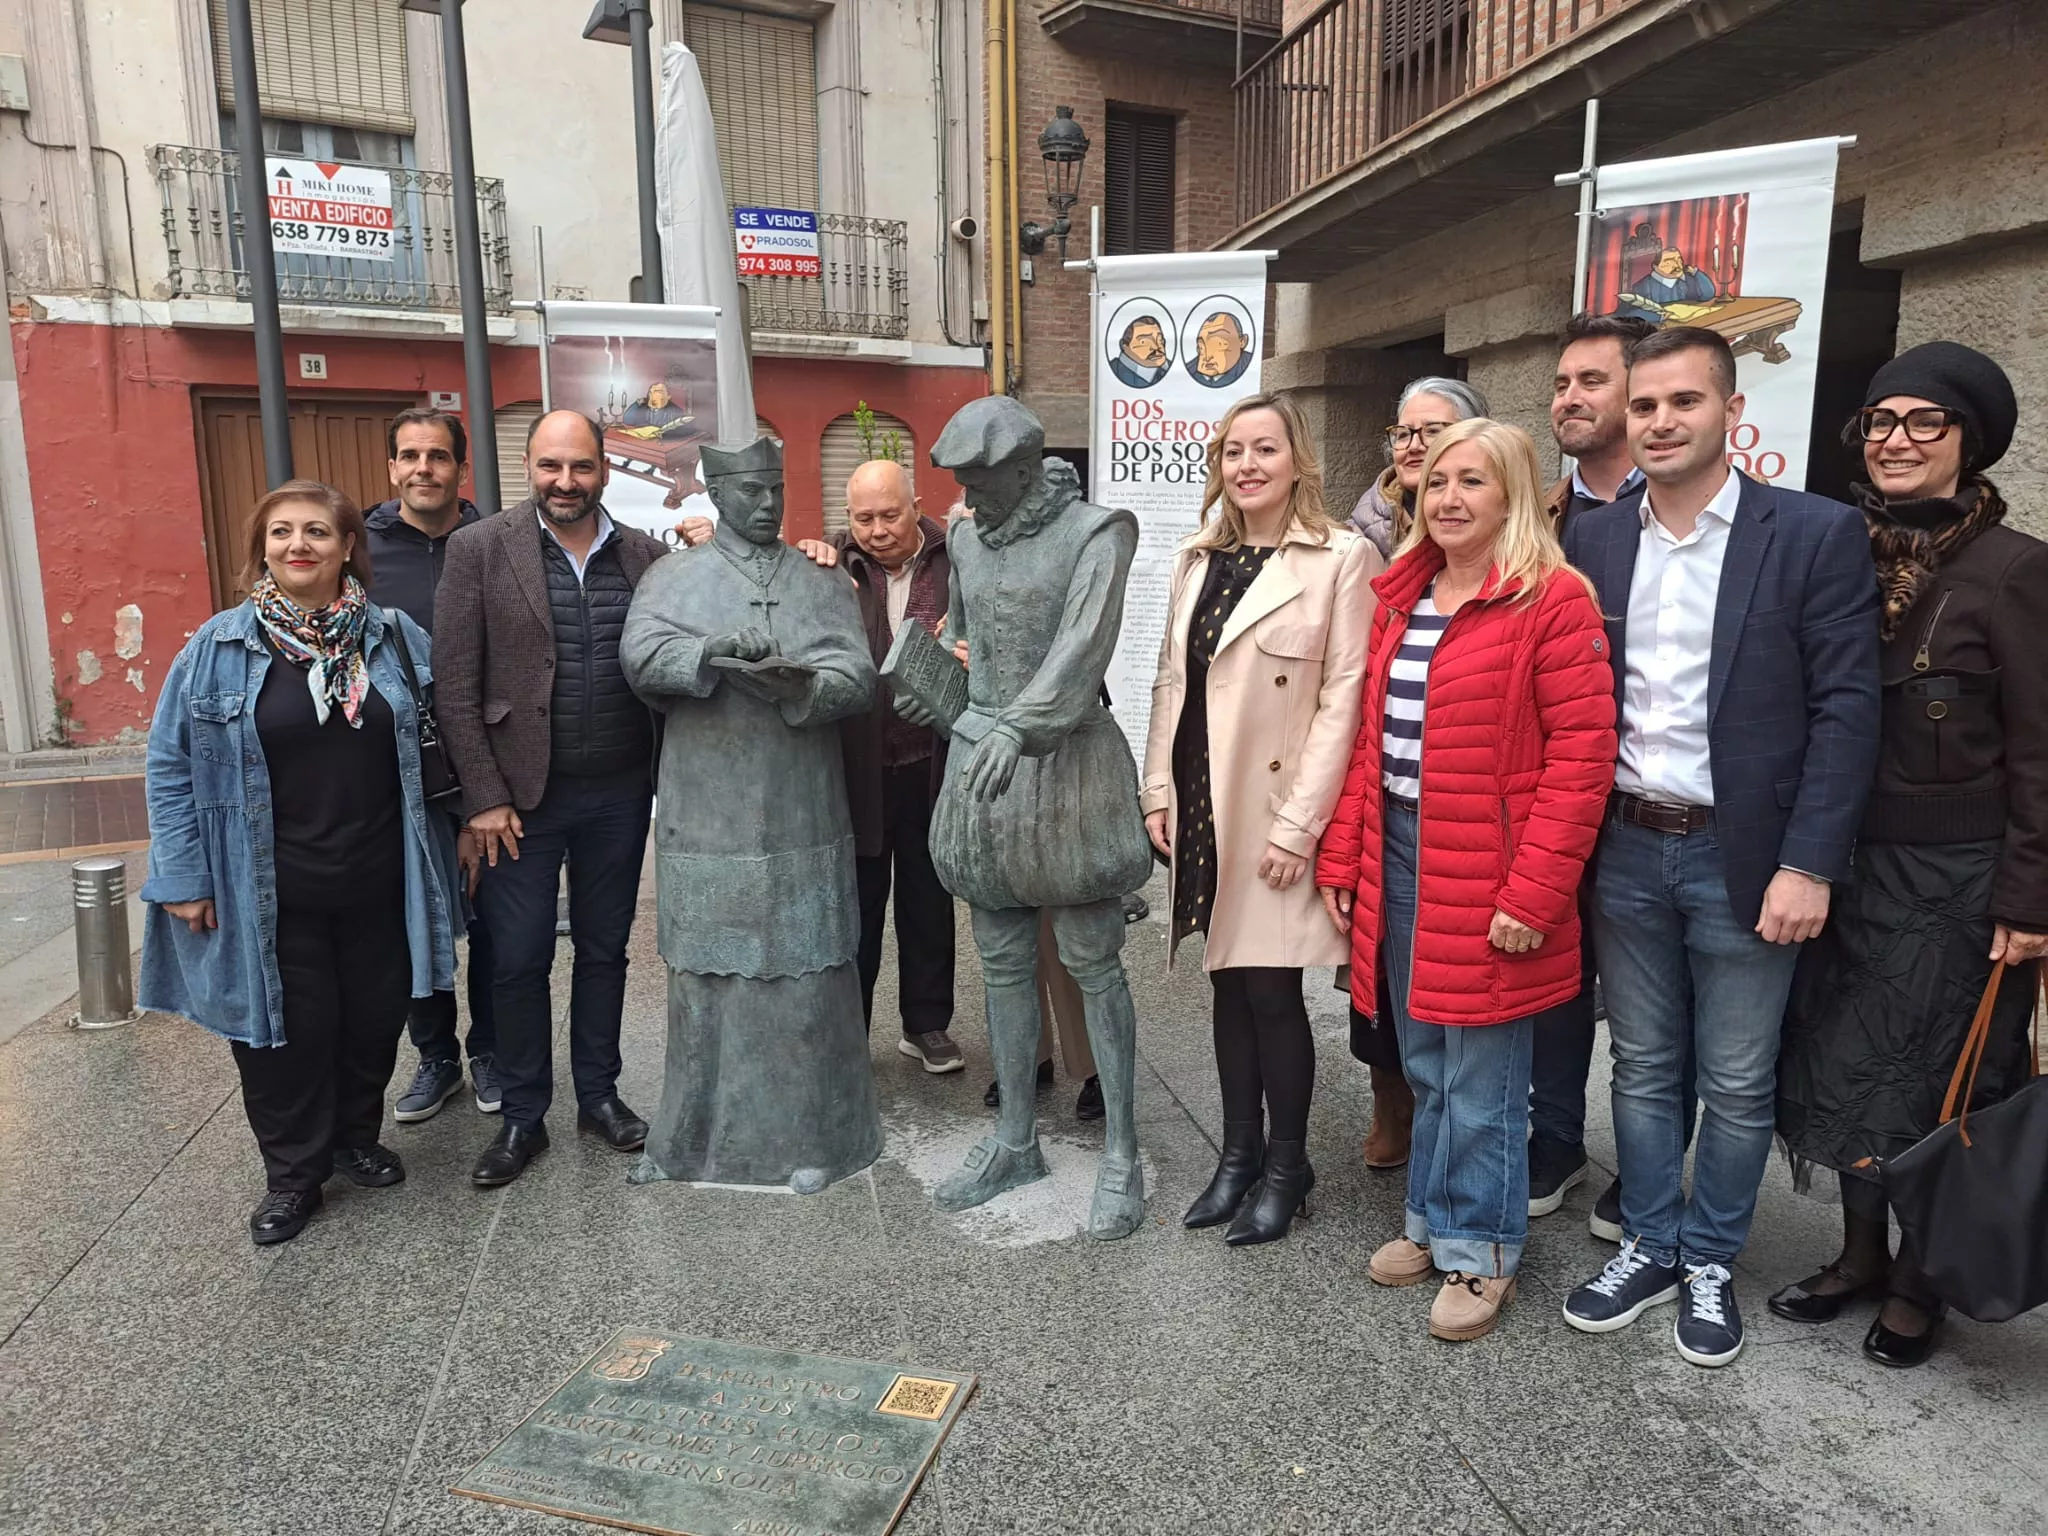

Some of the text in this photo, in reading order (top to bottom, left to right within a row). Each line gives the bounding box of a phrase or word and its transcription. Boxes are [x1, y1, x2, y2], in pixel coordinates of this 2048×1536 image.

[302, 180, 376, 195] MIKI HOME
[269, 198, 388, 226] VENTA EDIFICIO
[739, 213, 811, 228] SE VENDE
[272, 221, 390, 247] 638 779 873
[756, 236, 814, 248] PRADOSOL
[739, 257, 818, 273] 974 308 995
[304, 360, 321, 373] 38
[1112, 399, 1164, 420] DOS
[1111, 441, 1205, 462] DOS SO
[1111, 462, 1209, 483] DE POES
[677, 1362, 862, 1401] BARBASTRO
[706, 1391, 797, 1416] A SUS
[588, 1394, 883, 1455] ILUSTRES HIJOS
[592, 1445, 800, 1497] ARGENSOLA
[725, 1442, 745, 1459] Y
[750, 1446, 905, 1485] LUPERCIO
